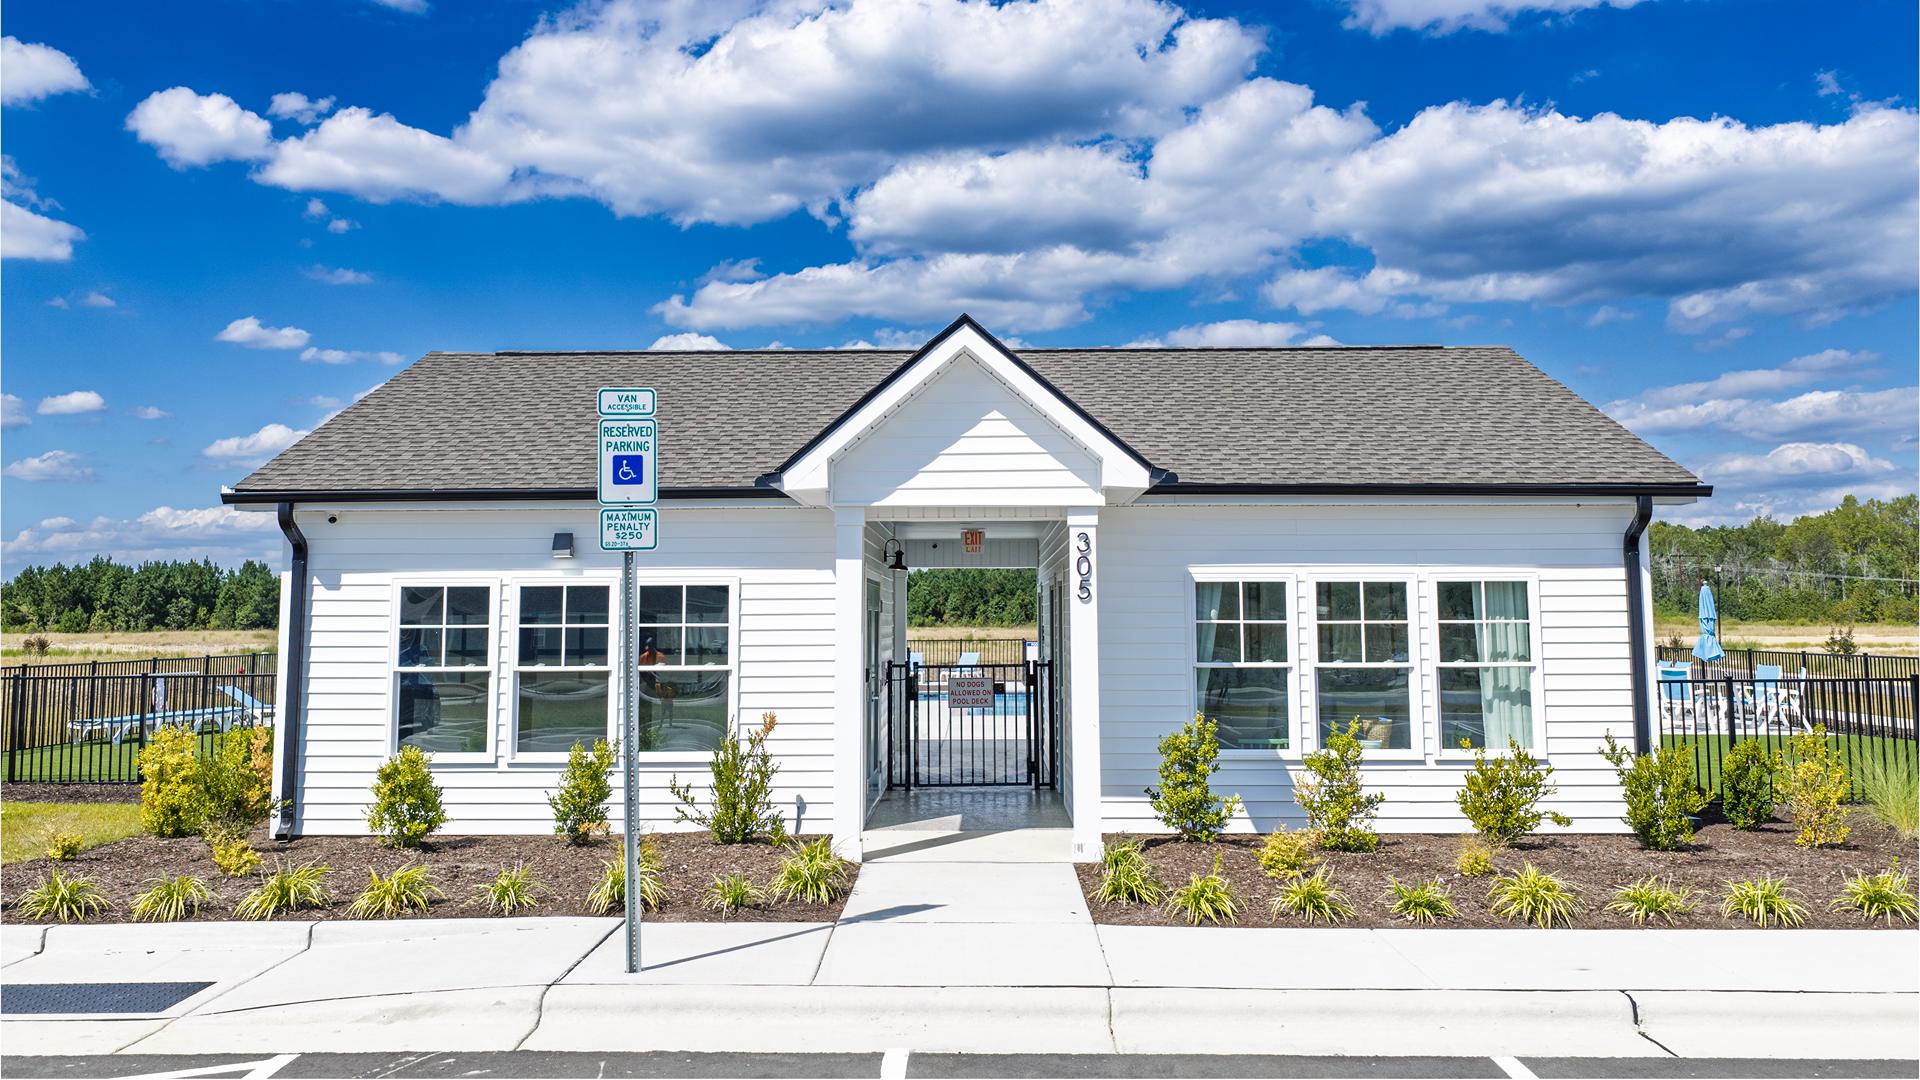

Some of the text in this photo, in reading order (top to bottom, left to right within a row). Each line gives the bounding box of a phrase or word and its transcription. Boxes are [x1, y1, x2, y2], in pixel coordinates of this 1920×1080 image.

[617, 394, 637, 403] VAN
[603, 426, 653, 437] RESERVED
[606, 441, 650, 452] PARKING
[606, 513, 652, 522] MAXIMUM
[606, 523, 650, 532] PENALTY
[615, 532, 643, 540] $250
[964, 531, 982, 545] EXIT
[1077, 532, 1091, 600] 305
